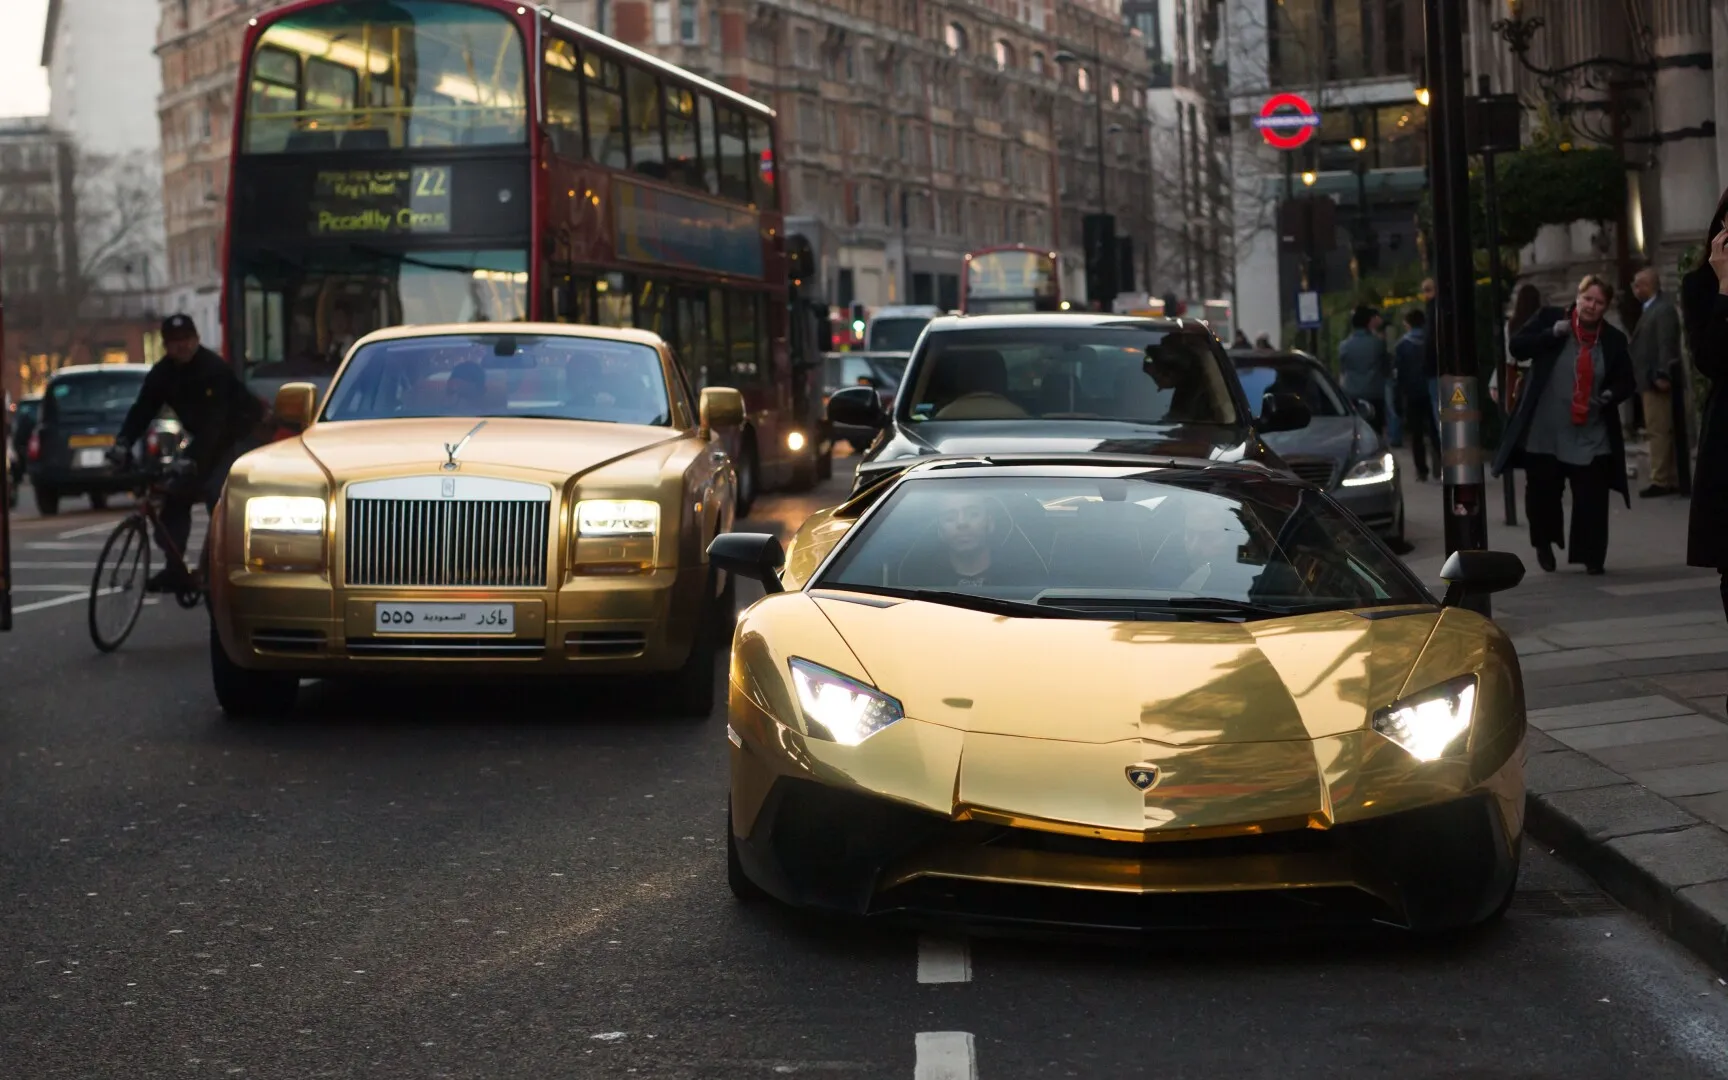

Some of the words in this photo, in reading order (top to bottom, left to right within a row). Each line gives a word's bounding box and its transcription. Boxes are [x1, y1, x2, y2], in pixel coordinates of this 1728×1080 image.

[415, 167, 447, 197] 22
[318, 209, 391, 232] Piccadilly
[397, 208, 447, 229] Circus
